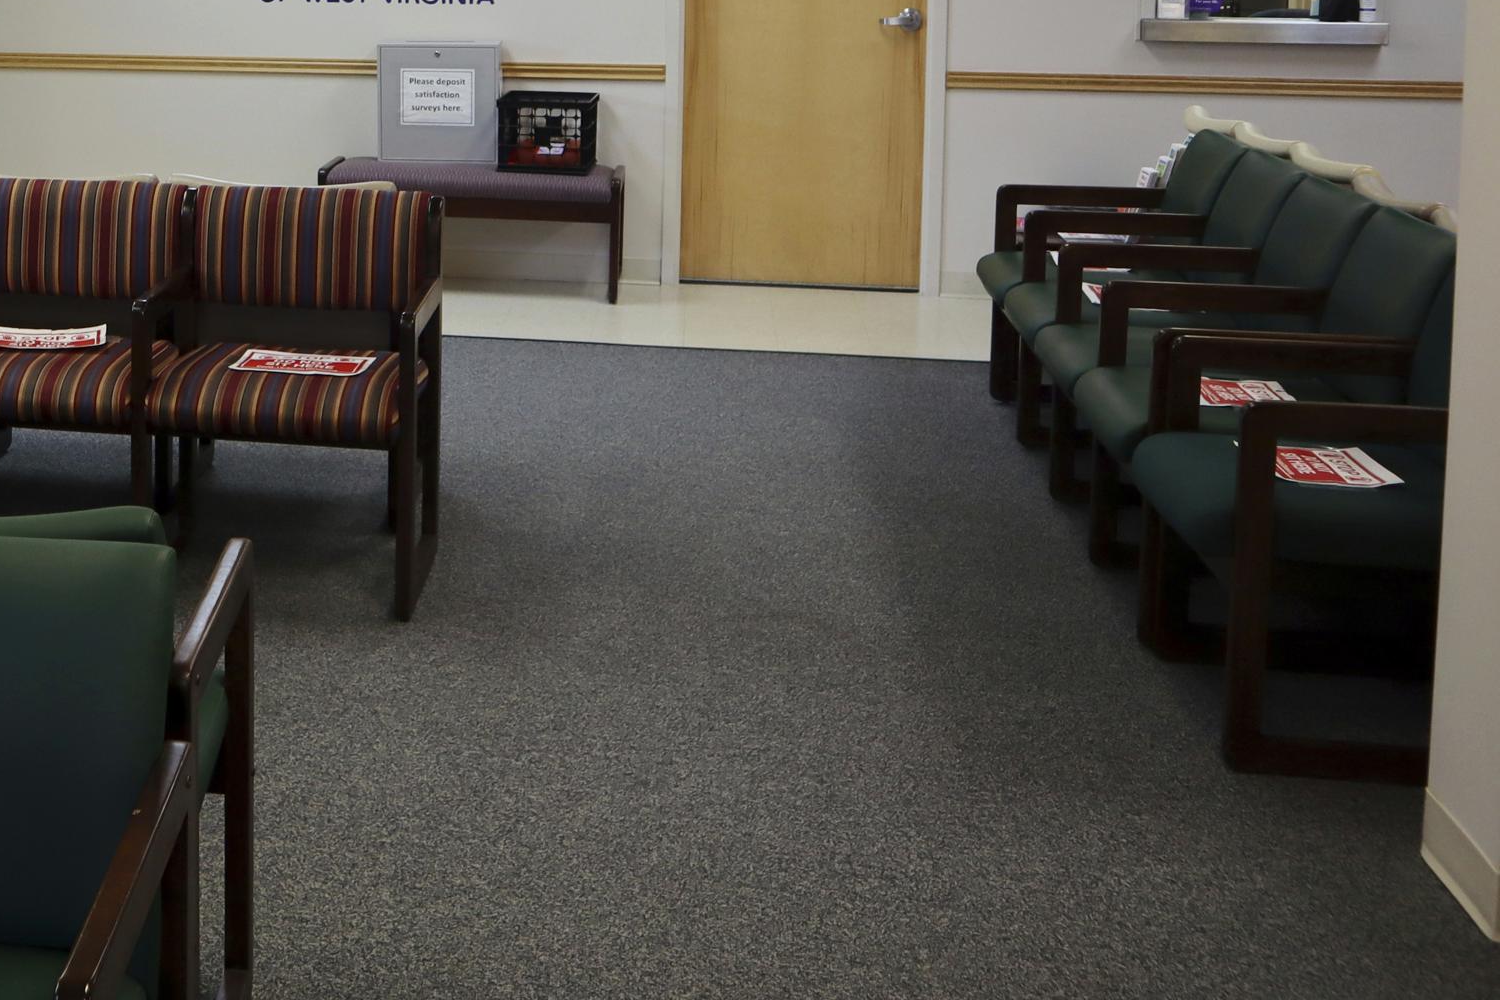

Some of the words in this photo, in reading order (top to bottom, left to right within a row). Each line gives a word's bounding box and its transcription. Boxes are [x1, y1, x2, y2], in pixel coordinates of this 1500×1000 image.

[409, 77, 434, 85] Please
[436, 78, 466, 86] deposit
[411, 104, 440, 112] surveys
